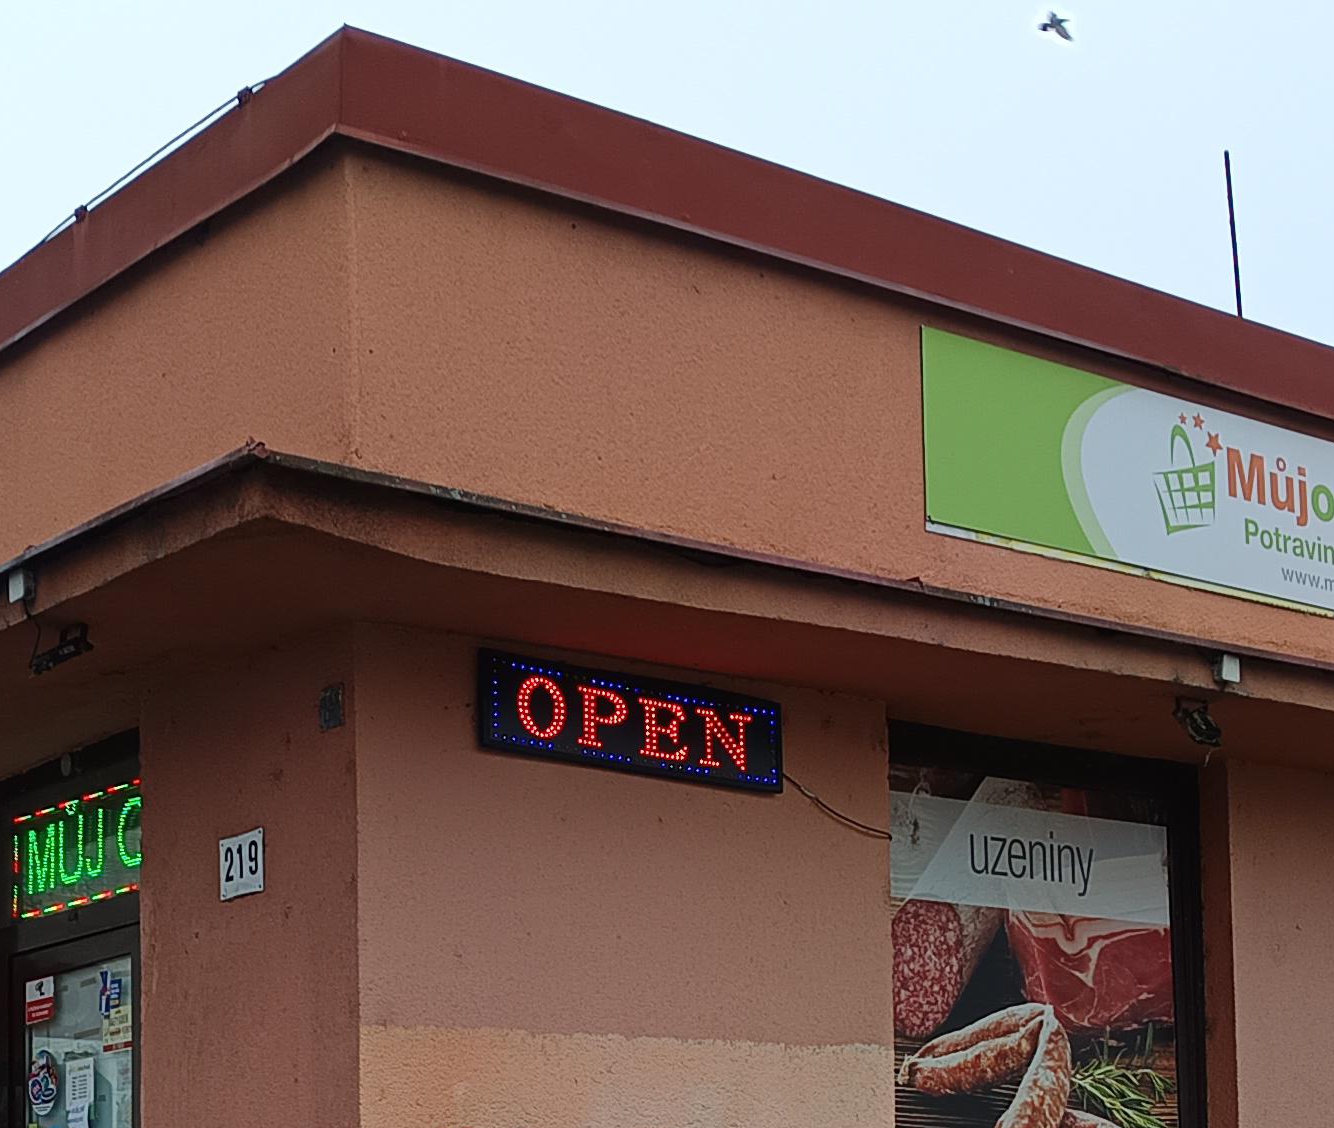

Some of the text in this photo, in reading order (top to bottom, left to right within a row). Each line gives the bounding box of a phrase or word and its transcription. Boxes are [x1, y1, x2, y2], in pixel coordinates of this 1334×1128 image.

[517, 675, 753, 772] OPEN
[224, 840, 259, 883] 219
[969, 830, 1094, 897] uzeniny
